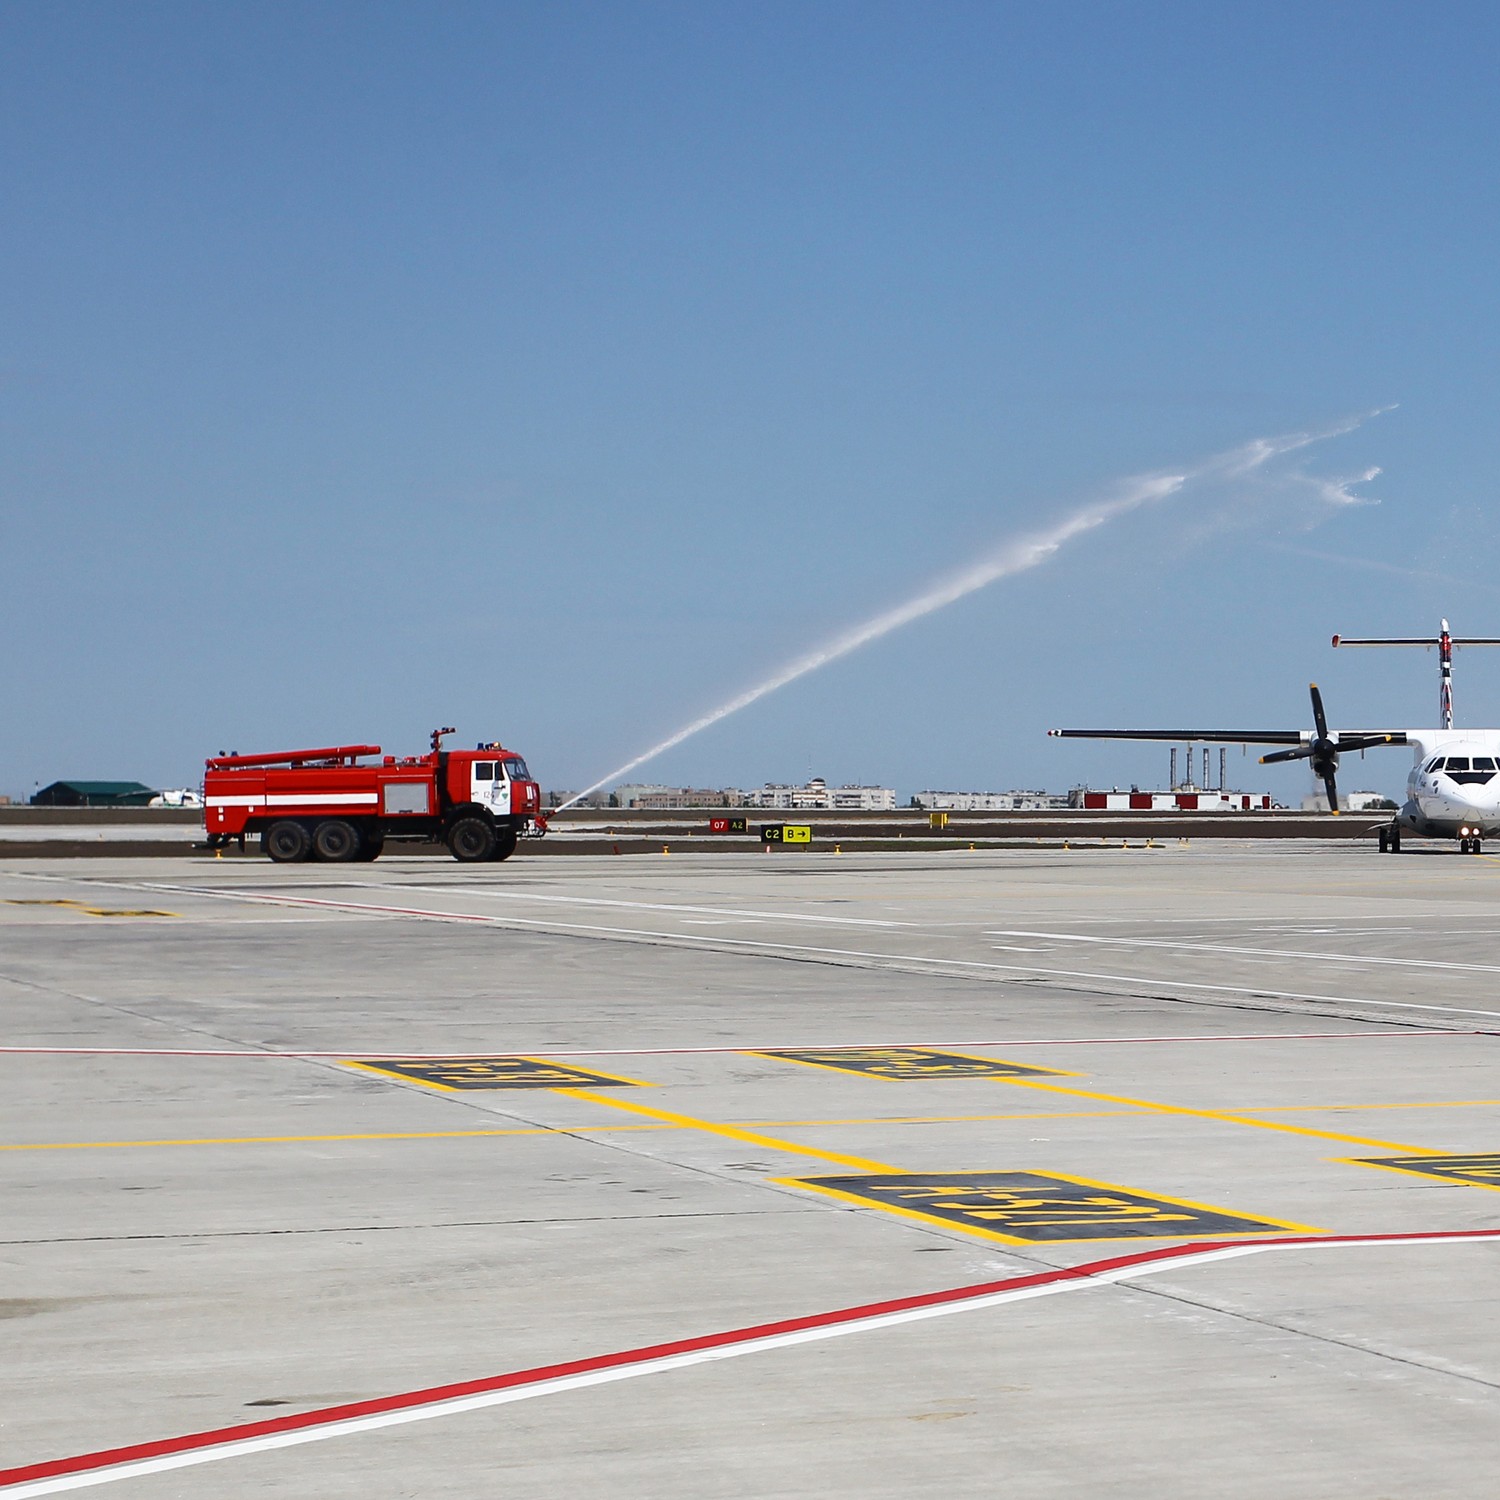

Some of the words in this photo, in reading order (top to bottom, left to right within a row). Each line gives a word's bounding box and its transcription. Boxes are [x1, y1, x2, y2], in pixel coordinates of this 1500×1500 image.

[714, 821, 725, 829] 07
[765, 829, 780, 839] C2
[787, 829, 794, 838] B
[871, 1186, 1199, 1227] A-321
